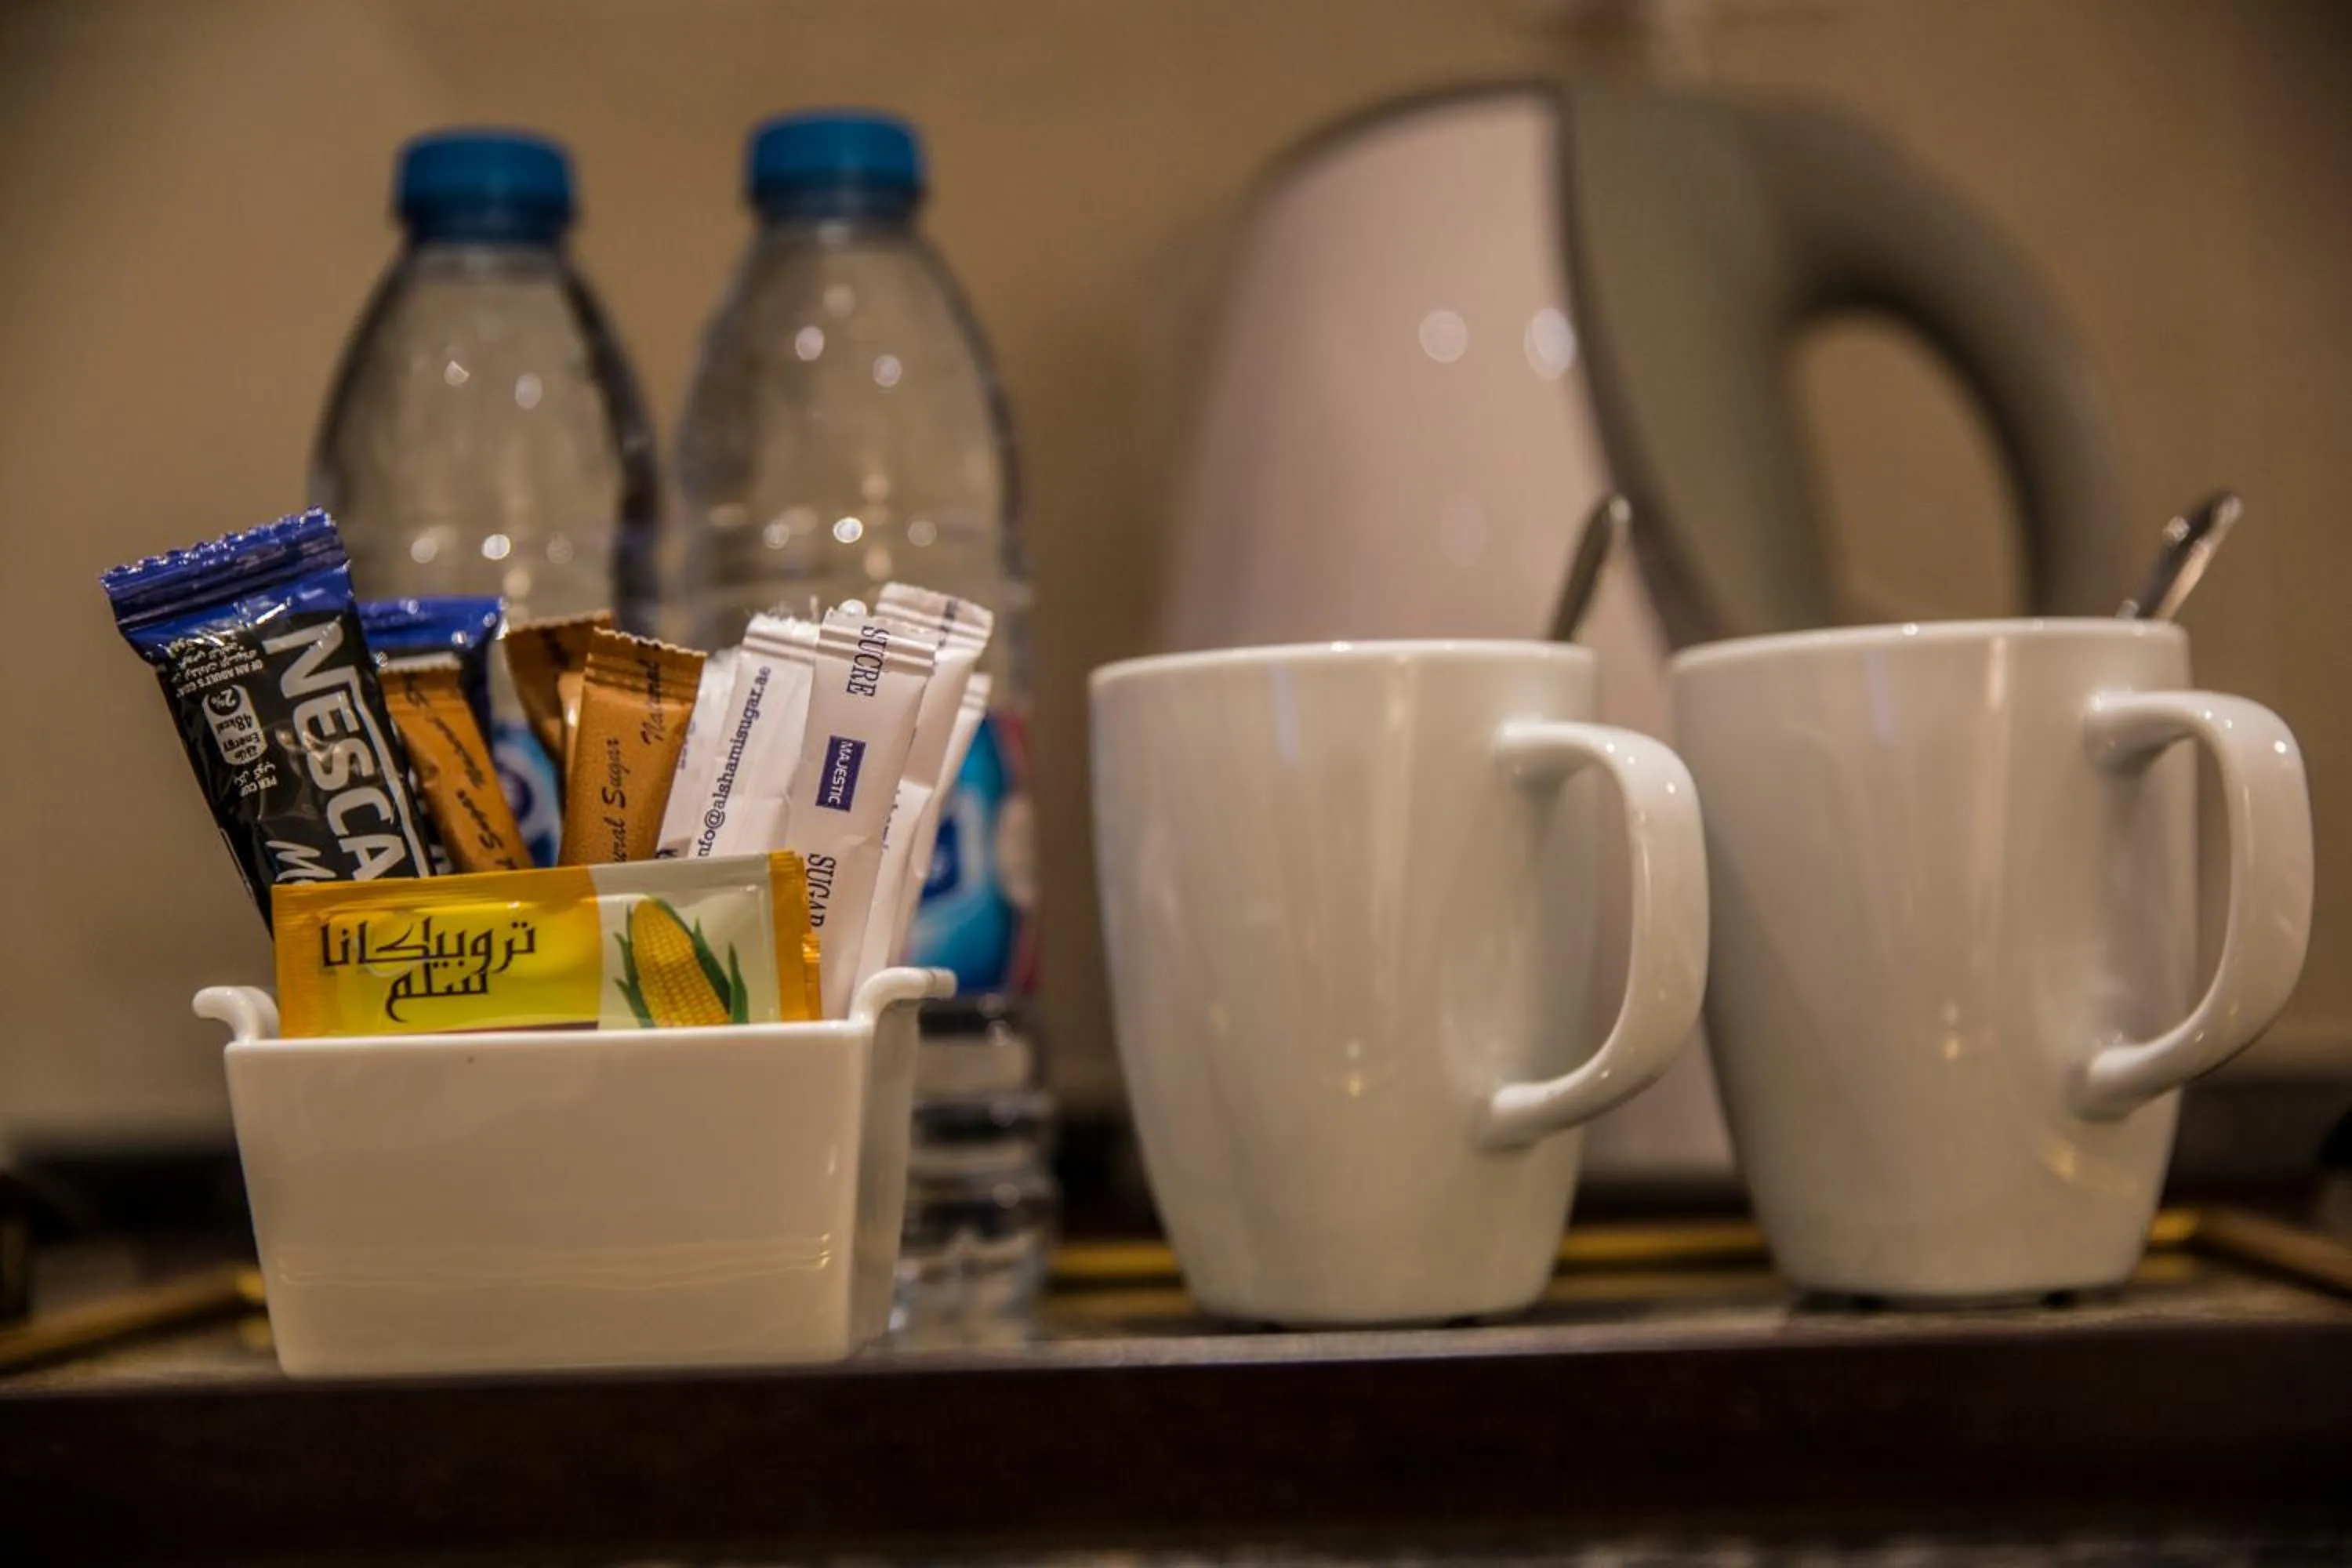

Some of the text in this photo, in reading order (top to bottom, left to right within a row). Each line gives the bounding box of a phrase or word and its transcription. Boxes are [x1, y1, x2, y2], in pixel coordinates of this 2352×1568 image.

[846, 625, 891, 698] SUCRE
[601, 737, 631, 809] Sugar
[827, 738, 854, 805] MAJESTIC
